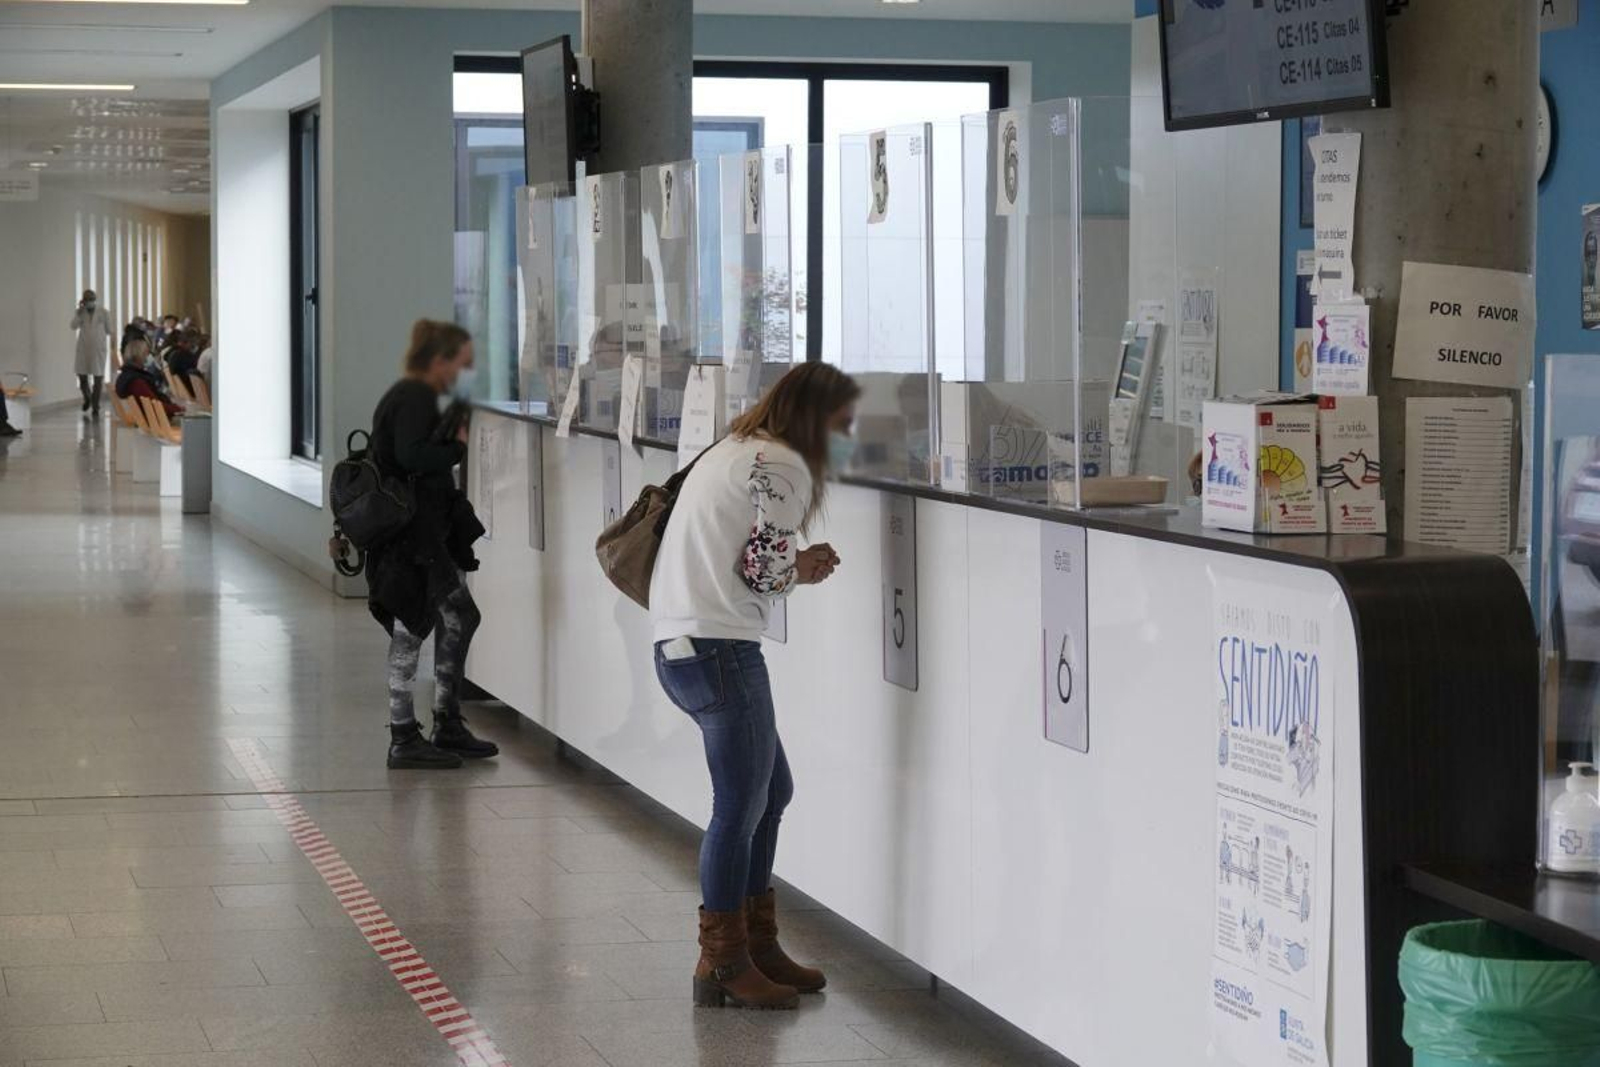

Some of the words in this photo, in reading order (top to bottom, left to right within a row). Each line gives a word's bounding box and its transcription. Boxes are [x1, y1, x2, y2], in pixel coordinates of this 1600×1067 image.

[1277, 21, 1319, 49] CE-115
[1324, 21, 1347, 39] Citas
[1348, 17, 1360, 34] 04
[1280, 57, 1322, 85] CE-114
[1326, 57, 1349, 75] Citas
[1003, 120, 1018, 204] 6
[1429, 301, 1462, 317] POR
[1478, 305, 1518, 322] FAVOR
[1438, 348, 1502, 366] SILENCIO
[893, 588, 905, 649] 5
[1057, 634, 1072, 704] 6
[1219, 636, 1319, 741] SENTIDIÑO
